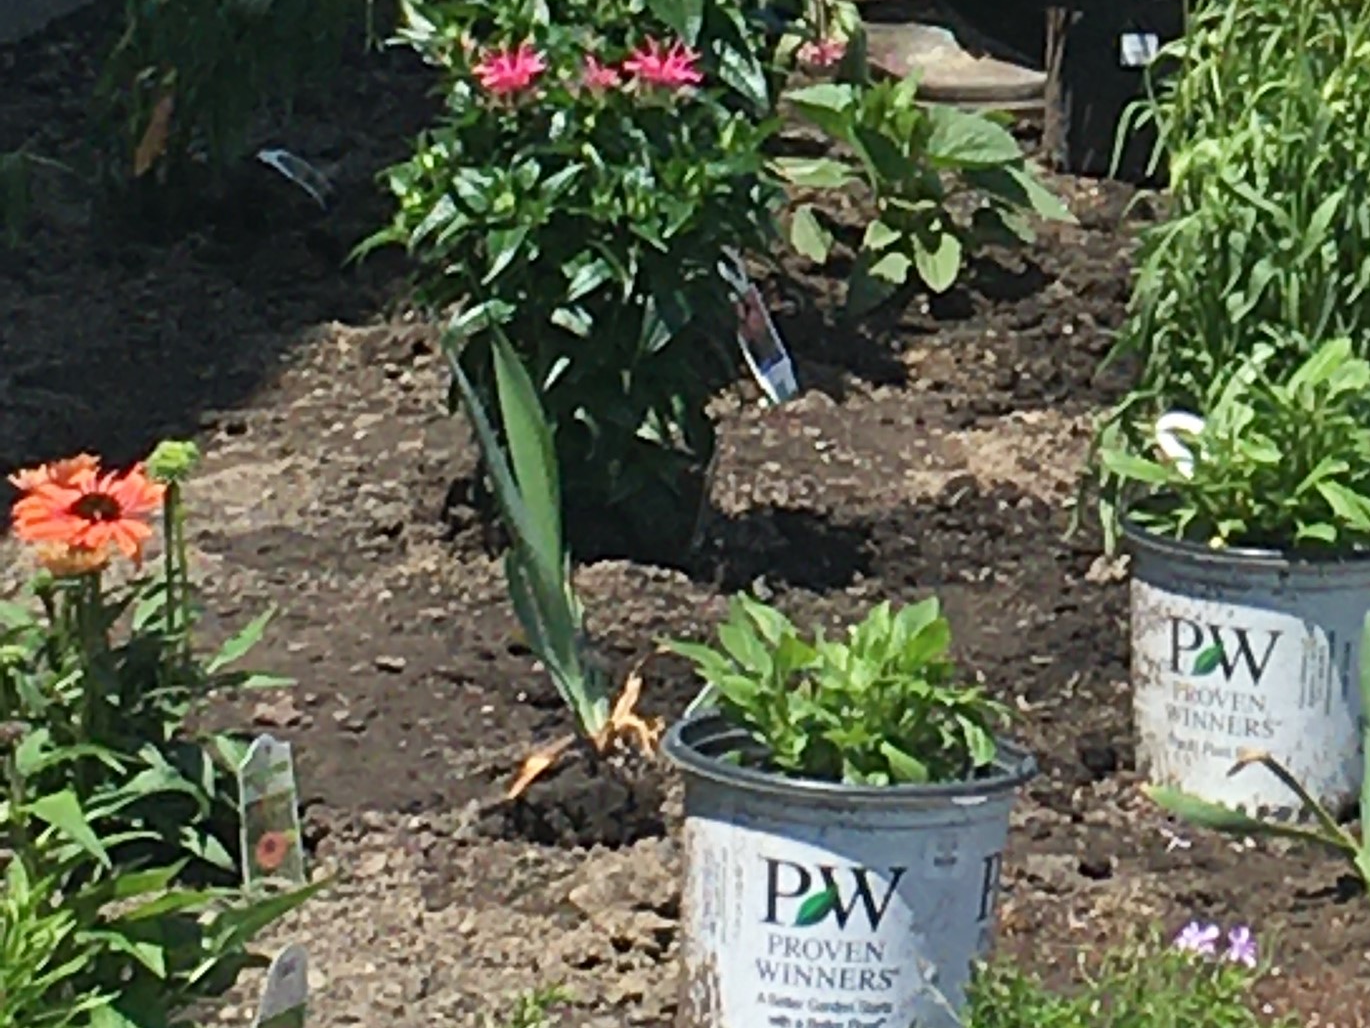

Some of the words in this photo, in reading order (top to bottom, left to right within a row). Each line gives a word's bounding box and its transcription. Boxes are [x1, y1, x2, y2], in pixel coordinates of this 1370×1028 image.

[1168, 615, 1284, 686] PW
[757, 854, 907, 932] PW
[768, 933, 886, 963] PROVEN
[755, 958, 893, 991] WINNERS
